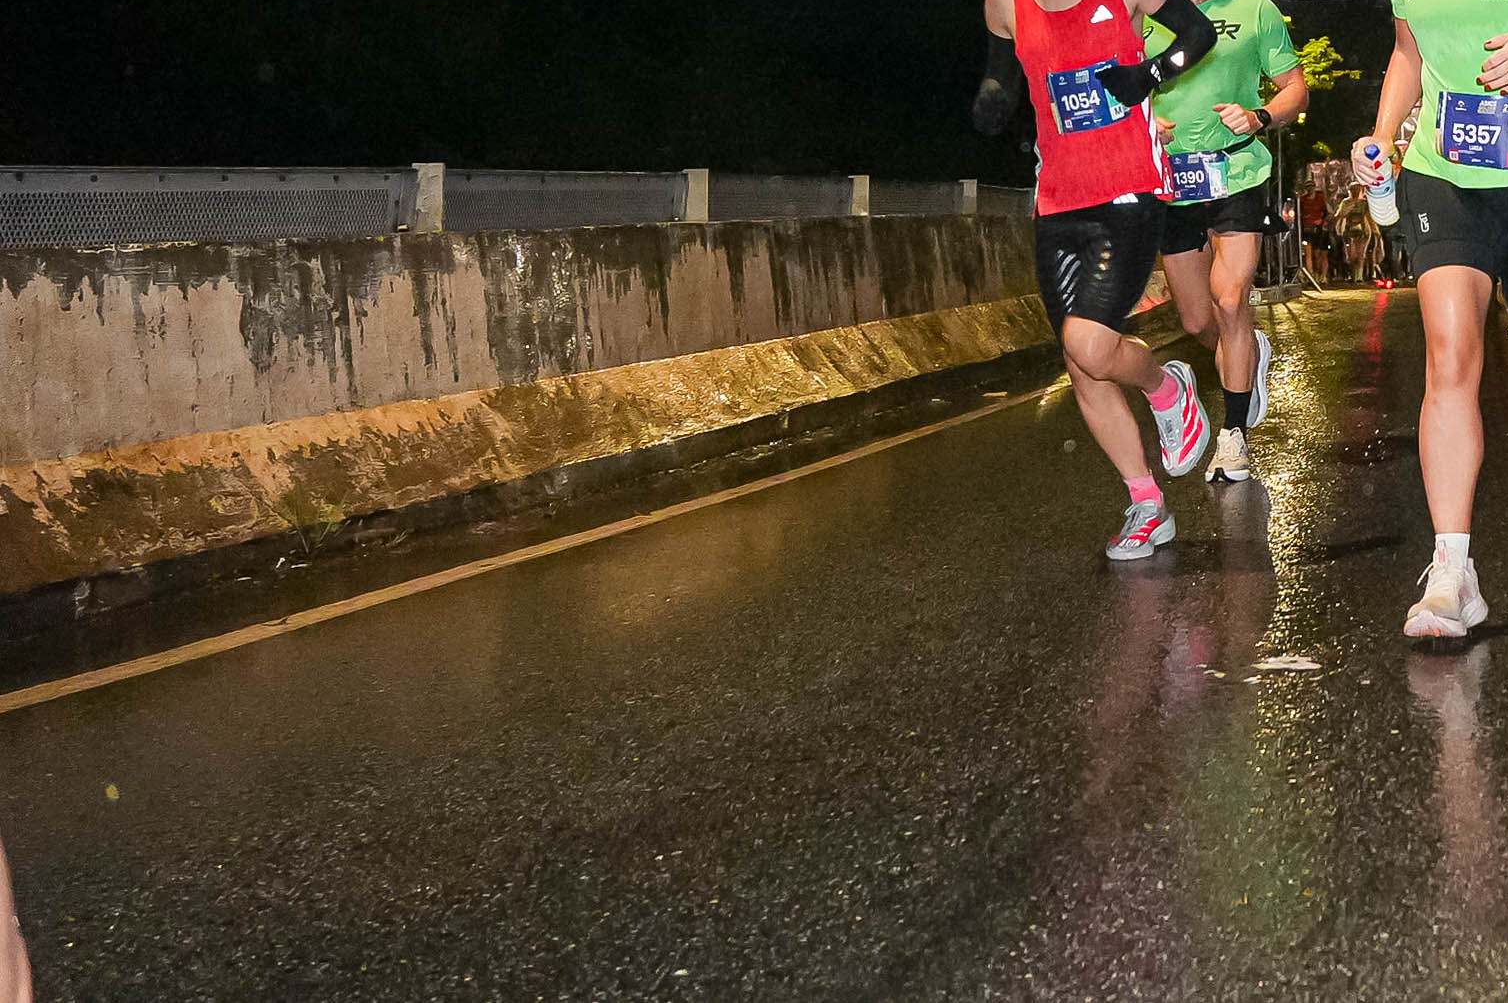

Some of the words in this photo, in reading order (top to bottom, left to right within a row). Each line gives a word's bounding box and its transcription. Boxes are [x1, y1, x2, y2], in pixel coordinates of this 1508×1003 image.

[1061, 89, 1101, 112] 1054
[1452, 123, 1502, 145] 5357
[1173, 170, 1205, 185] 1390
